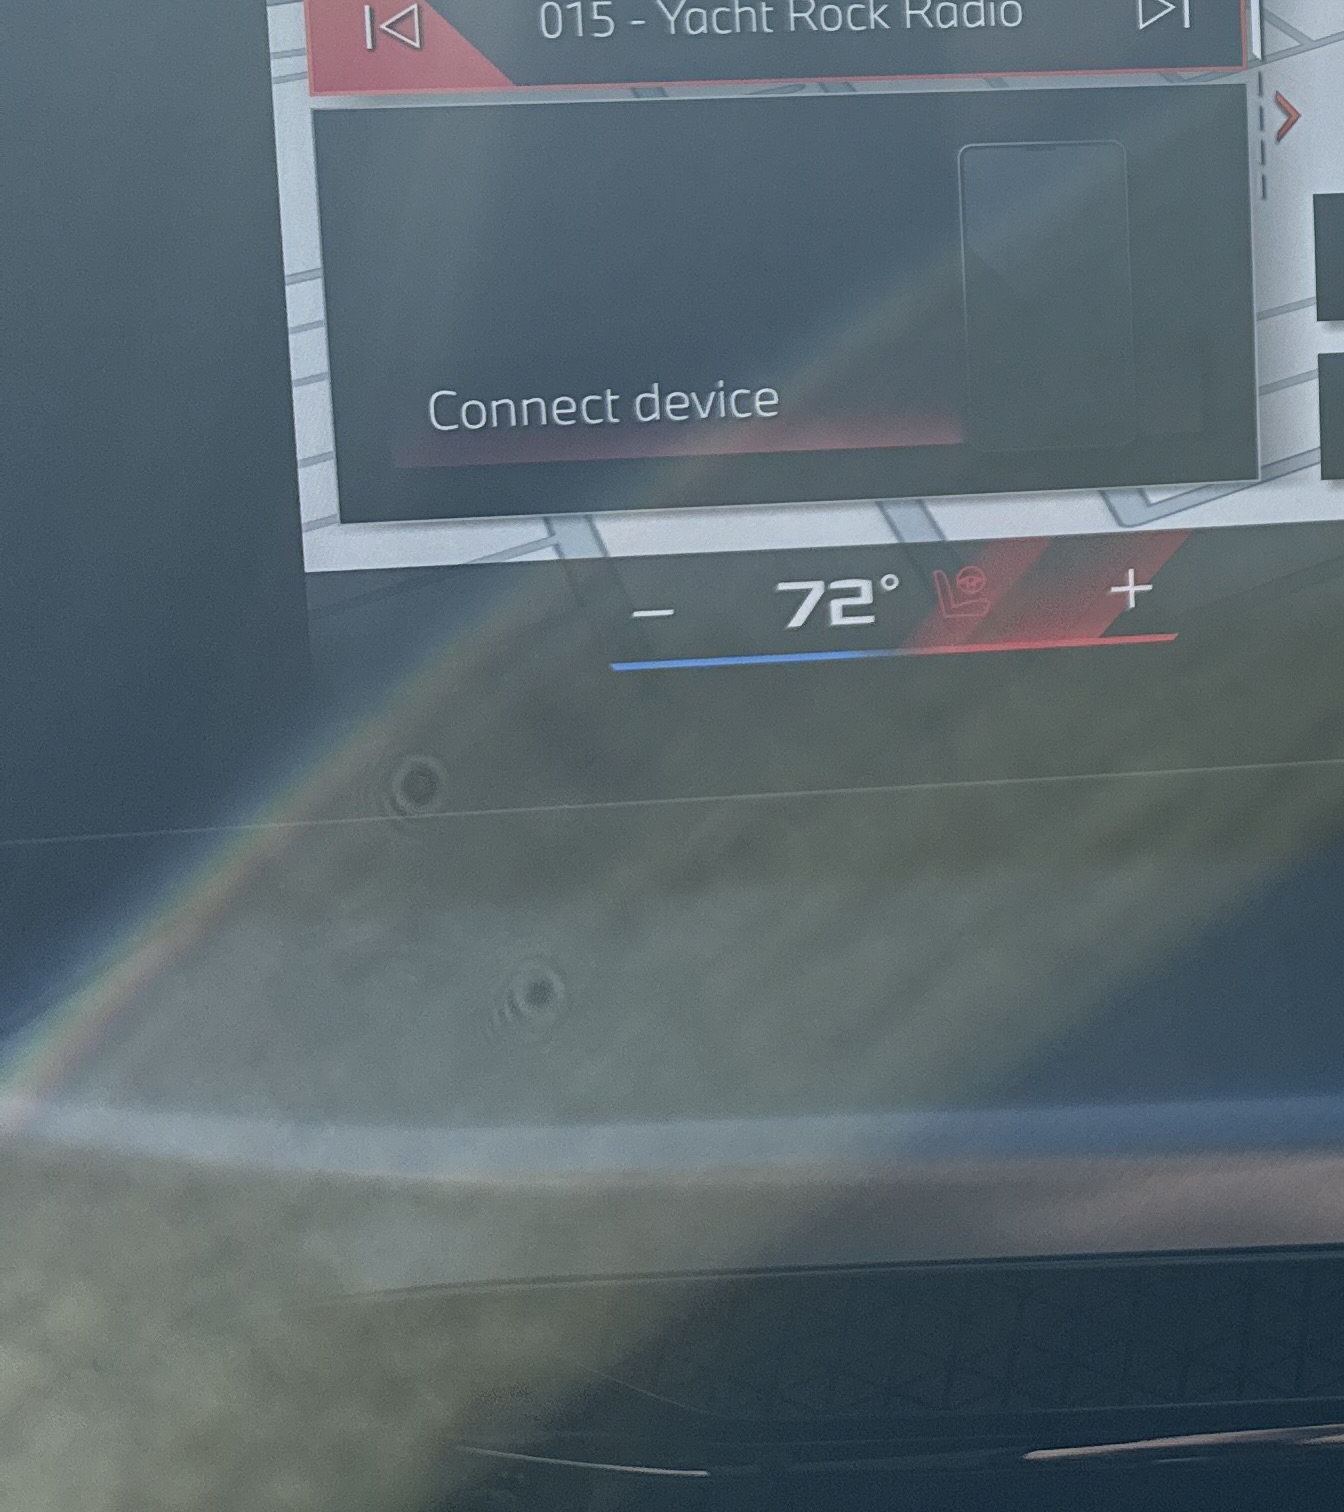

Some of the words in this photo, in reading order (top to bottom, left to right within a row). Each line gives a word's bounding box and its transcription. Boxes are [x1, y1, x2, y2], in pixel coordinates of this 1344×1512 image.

[428, 386, 622, 432] Connect
[634, 380, 780, 423] device
[776, 573, 899, 630] 72°
